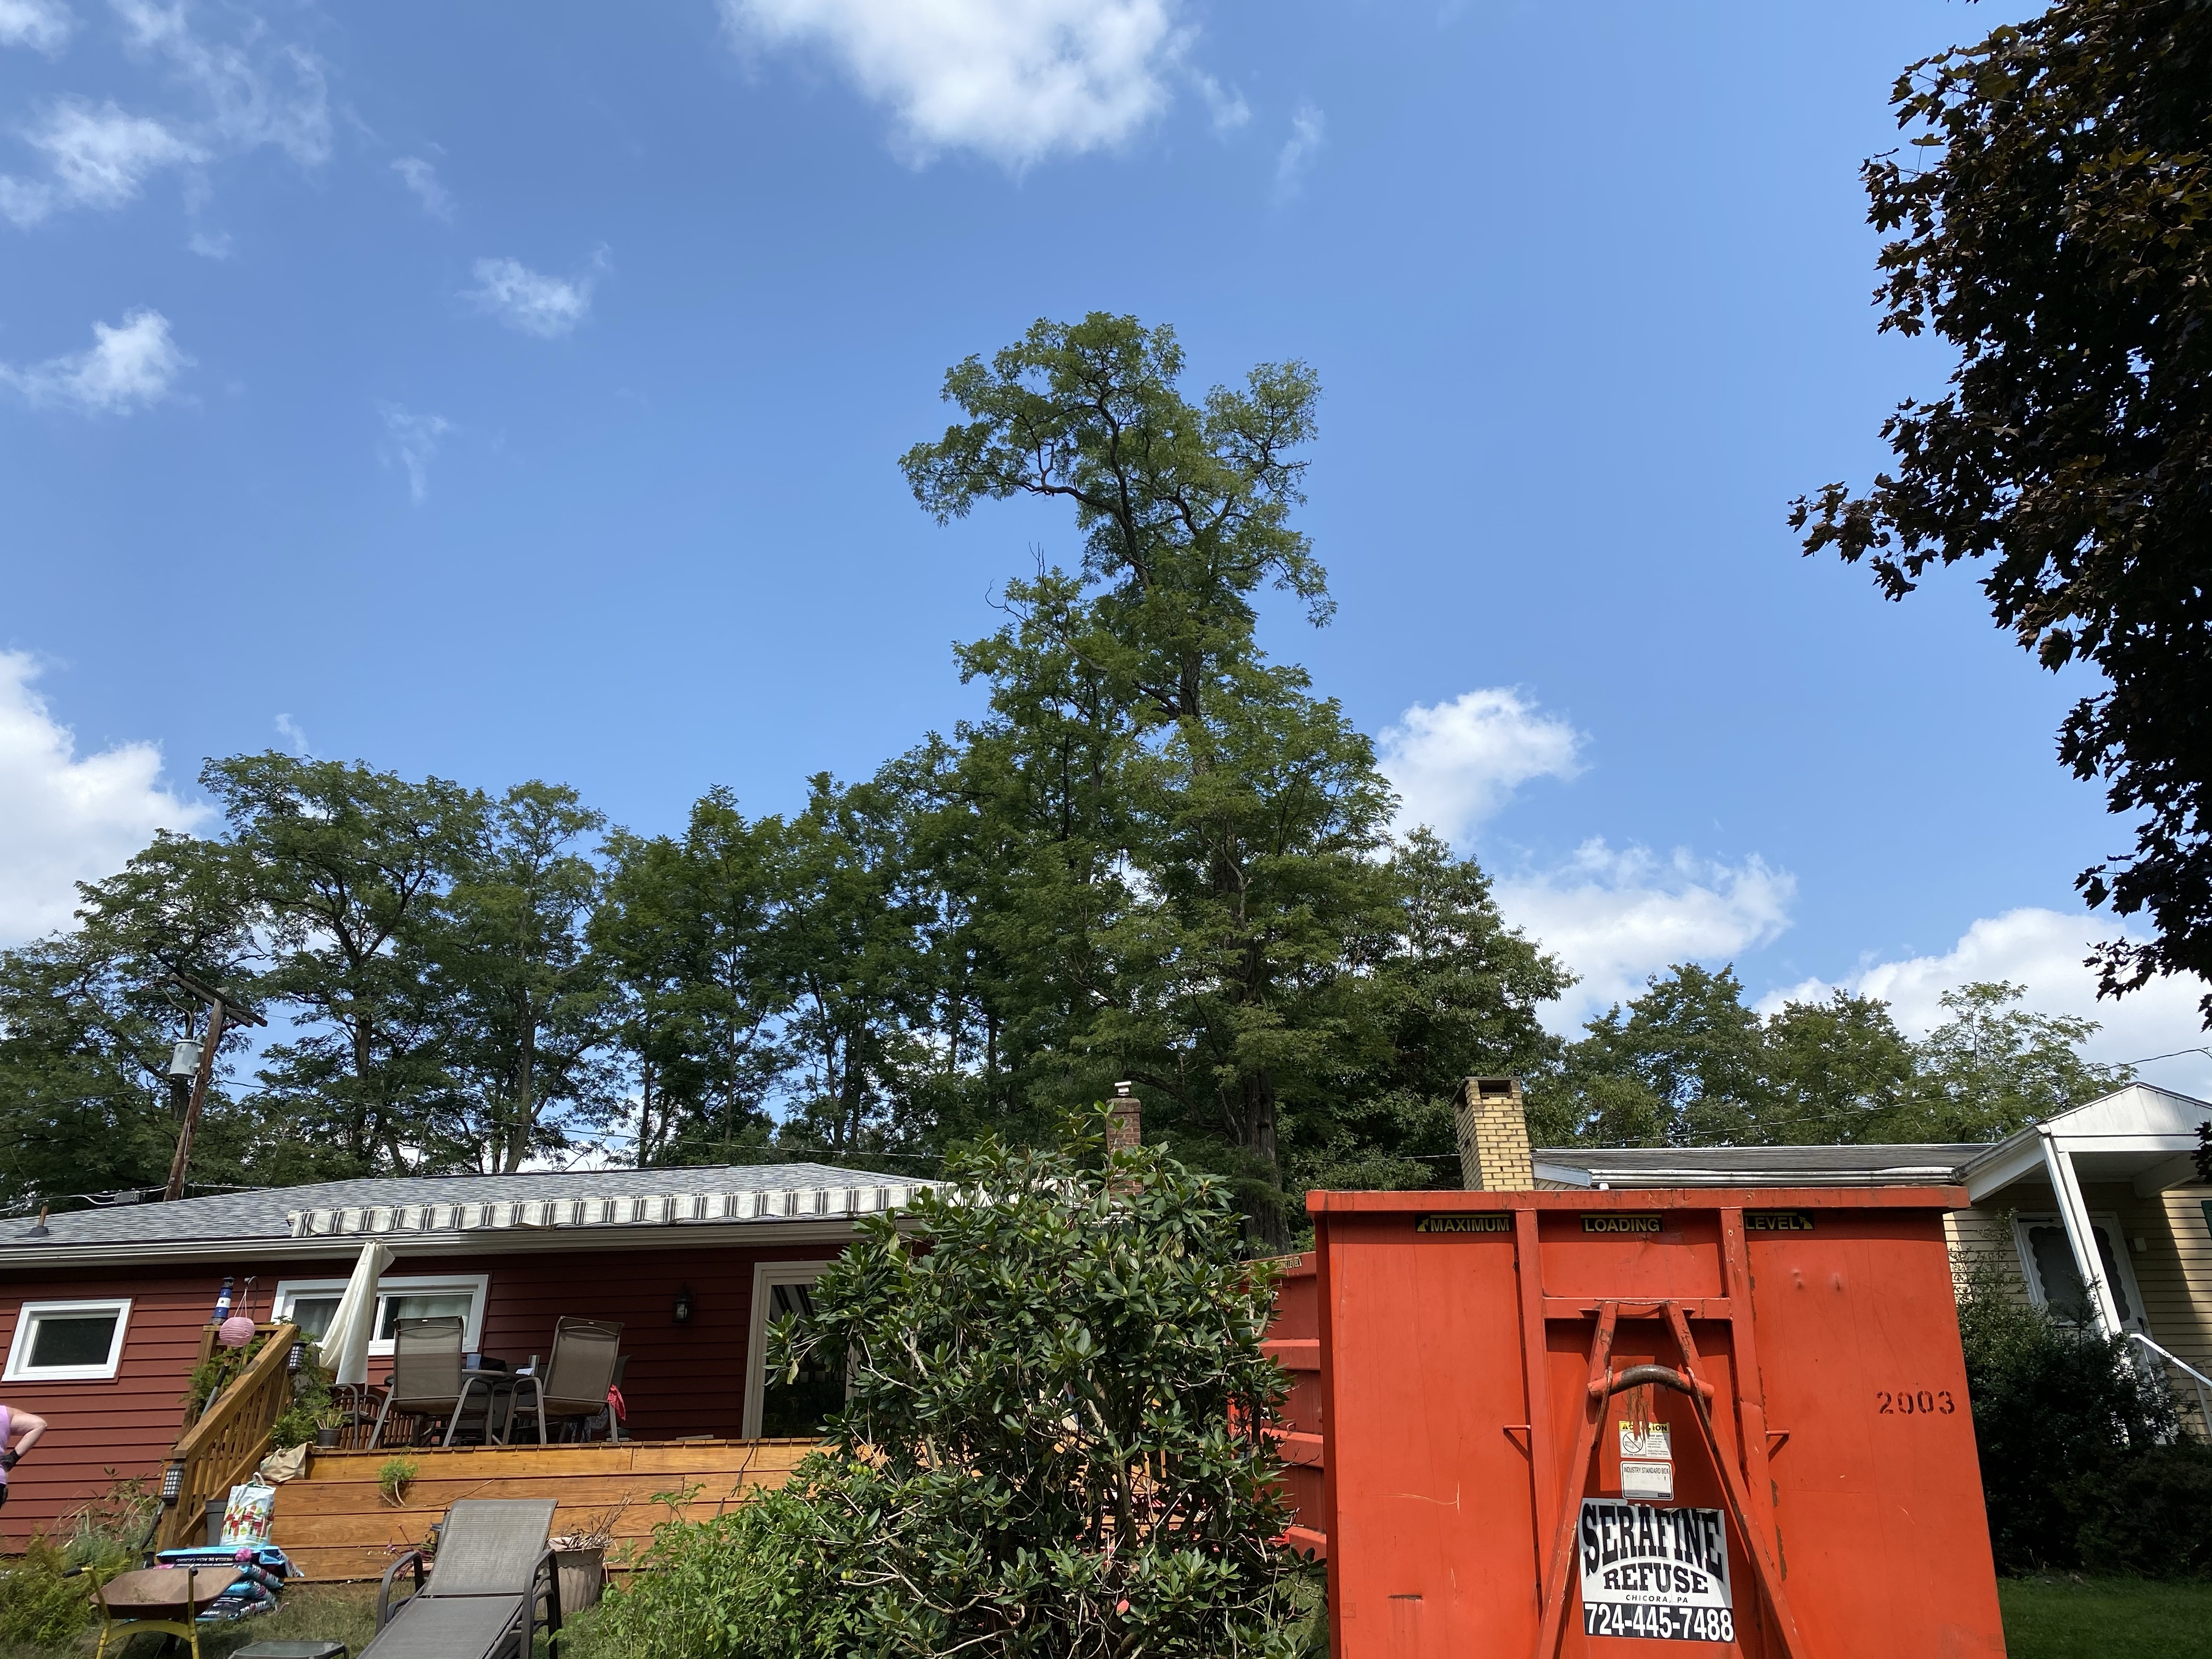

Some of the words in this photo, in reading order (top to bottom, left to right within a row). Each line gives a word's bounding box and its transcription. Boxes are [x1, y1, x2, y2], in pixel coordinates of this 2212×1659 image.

[1430, 1218, 1509, 1232] MAXIMUM
[1584, 1218, 1660, 1232] LOADING
[1745, 1217, 1799, 1229] LEVEL
[1877, 1390, 1955, 1414] 2003
[1582, 1503, 1724, 1583] SERAFINE
[1603, 1562, 1708, 1594] REFUSE
[1626, 1594, 1672, 1602] CHICORA,
[1585, 1603, 1734, 1641] 724-445-7488
